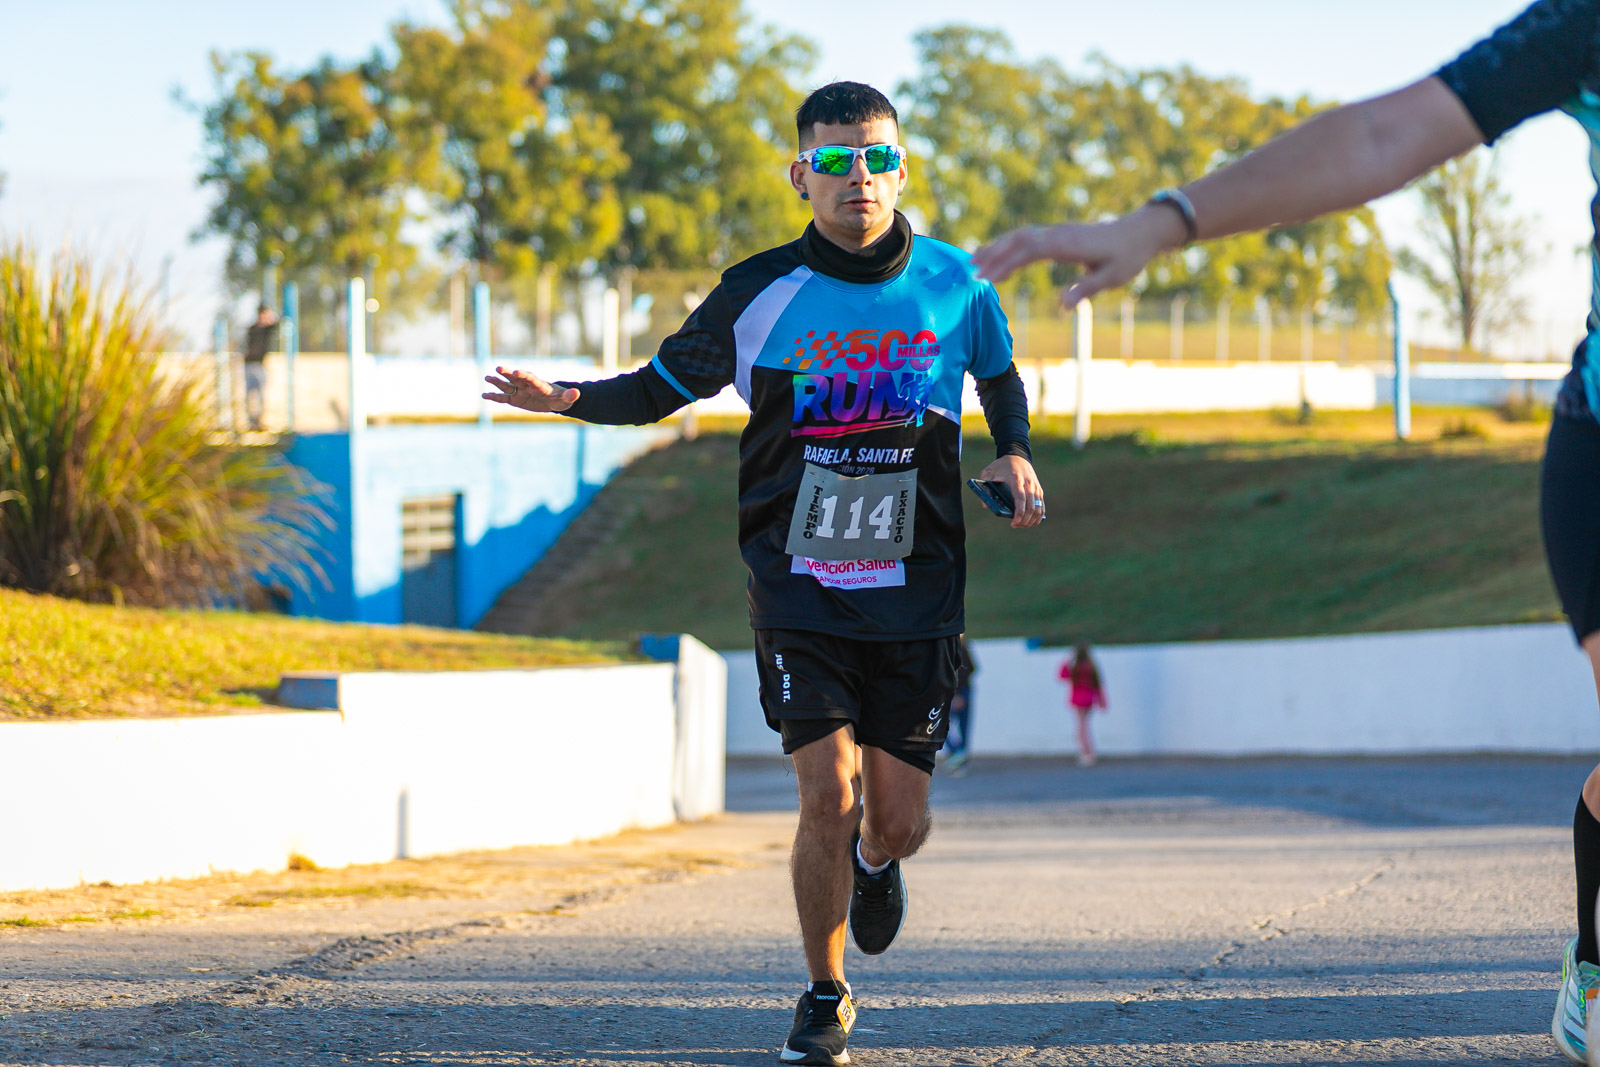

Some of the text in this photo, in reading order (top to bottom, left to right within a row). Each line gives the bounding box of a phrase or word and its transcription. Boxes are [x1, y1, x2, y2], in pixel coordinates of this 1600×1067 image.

[897, 345, 940, 358] MILLAS
[792, 371, 916, 423] RUN
[803, 444, 915, 465] RAFAELA, SANTA FE
[803, 485, 824, 540] TIEMPO
[816, 495, 894, 540] 114
[894, 489, 909, 544] EXACTO
[857, 559, 897, 572] Salud
[842, 576, 877, 585] SEGUROS
[783, 673, 790, 689] DO
